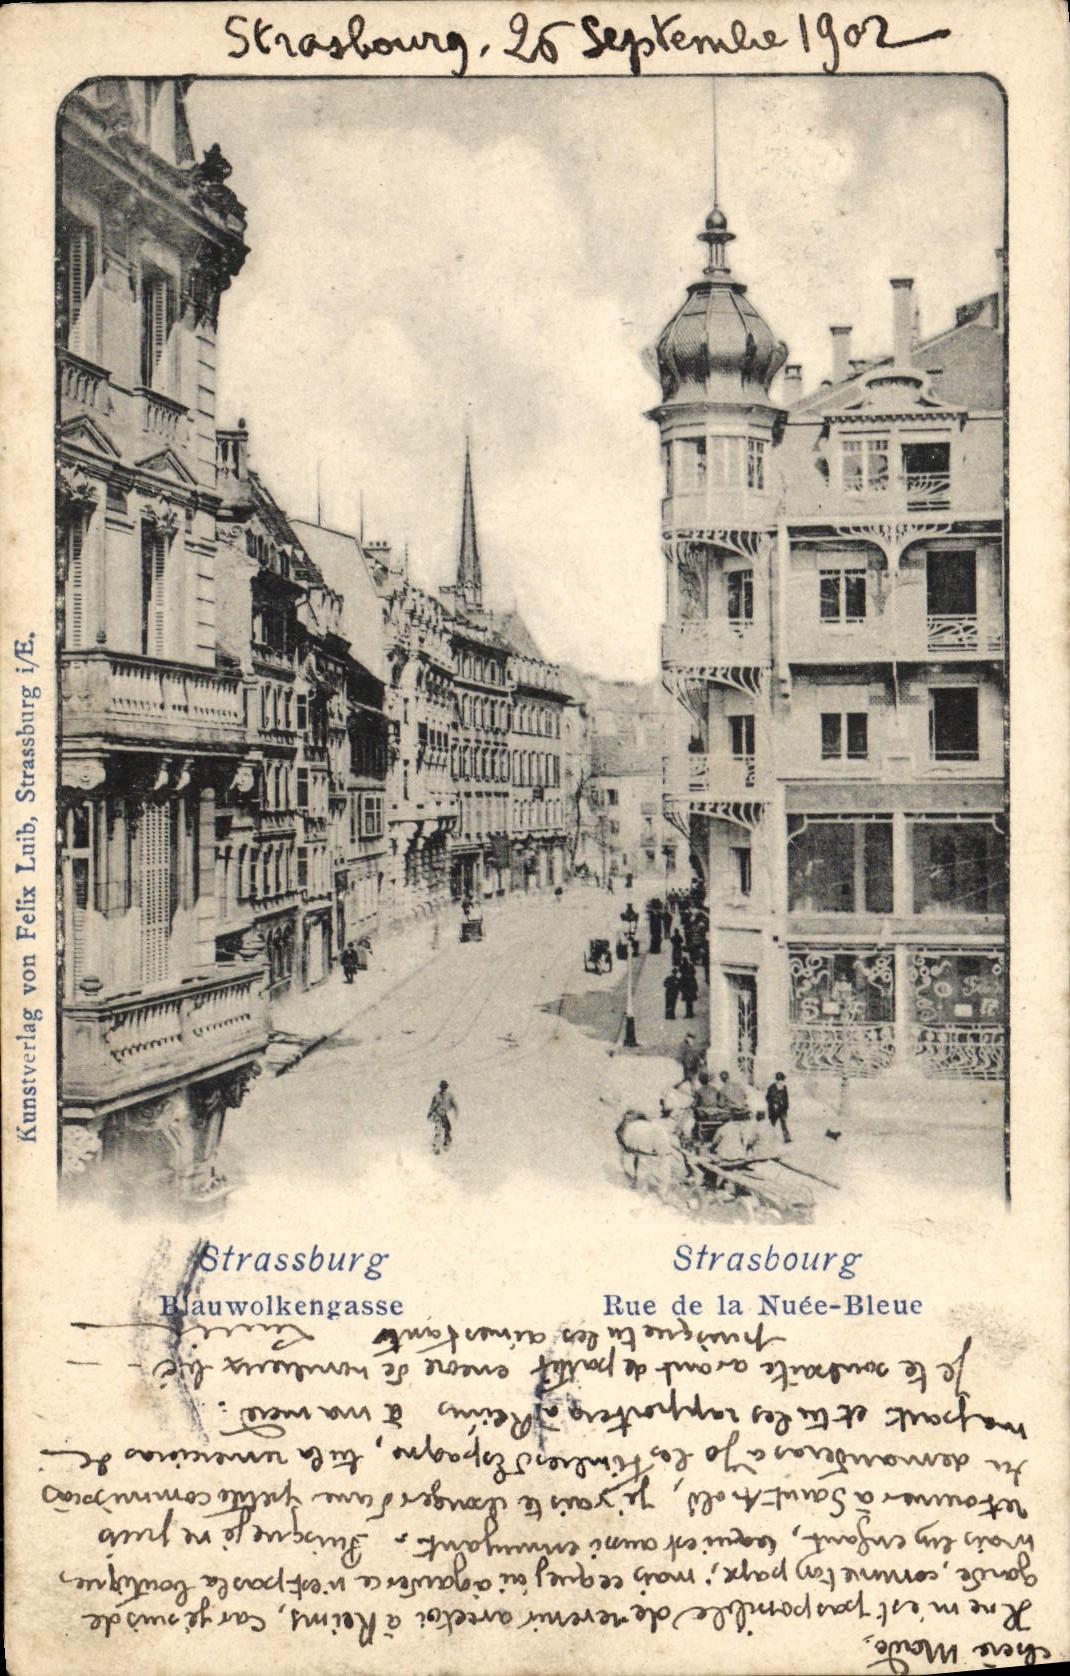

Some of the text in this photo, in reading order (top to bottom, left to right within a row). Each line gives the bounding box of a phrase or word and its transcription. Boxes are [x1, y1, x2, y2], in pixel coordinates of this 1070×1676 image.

[800, 12, 951, 74] 1902
[465, 1327, 546, 1349] aimes
[562, 1328, 598, 1351] les
[607, 1326, 635, 1352] tu
[221, 1357, 368, 1382] nombreux
[382, 1363, 409, 1385] de
[425, 1359, 509, 1379] encore
[623, 1359, 646, 1382] de
[655, 1360, 748, 1386] avant
[760, 1360, 889, 1392] souhaite
[899, 1360, 927, 1393] te
[936, 1336, 971, 1399] Je
[318, 1406, 371, 1423] ma
[383, 1404, 402, 1429] à
[752, 1405, 792, 1436] les
[797, 1407, 828, 1431] tu
[833, 1405, 867, 1429] et
[885, 1396, 977, 1433] part
[975, 1414, 1026, 1440] ma
[297, 1447, 321, 1472] la
[330, 1450, 363, 1475] tu
[650, 1448, 694, 1472] les
[745, 1449, 766, 1473] à
[774, 1445, 970, 1480] demanderas
[203, 1479, 301, 1518] petite
[518, 1495, 543, 1522] te
[622, 1475, 656, 1517] je
[853, 1491, 874, 1514] à
[96, 1508, 170, 1558] puis
[181, 1527, 210, 1548] ne
[221, 1508, 252, 1551] je
[251, 1505, 368, 1569] Puisque
[792, 1515, 906, 1556] enfant,
[964, 1531, 1034, 1554] mais
[588, 1535, 658, 1559] aussi
[663, 1534, 697, 1562] est
[233, 1567, 284, 1593] pas
[354, 1575, 382, 1591] ce
[498, 1556, 549, 1596] j'ai
[547, 1561, 596, 1588] que
[599, 1575, 623, 1590] ce
[633, 1566, 694, 1596] mais
[795, 1549, 835, 1592] ton
[841, 1566, 938, 1585] comme
[943, 1551, 1038, 1592] garde,
[199, 1575, 229, 1600] la
[285, 1574, 345, 1600] n'est
[472, 1578, 492, 1600] à
[183, 1598, 212, 1632] je
[672, 1593, 812, 1636] possible
[816, 1590, 871, 1620] pas
[876, 1599, 958, 1627] m'est
[969, 1599, 996, 1615] ne
[81, 1613, 120, 1638] de
[126, 1612, 179, 1632] suis
[278, 1604, 376, 1648] Reims,
[383, 1614, 402, 1638] à
[518, 1608, 629, 1633] revenir
[630, 1604, 670, 1633] de
